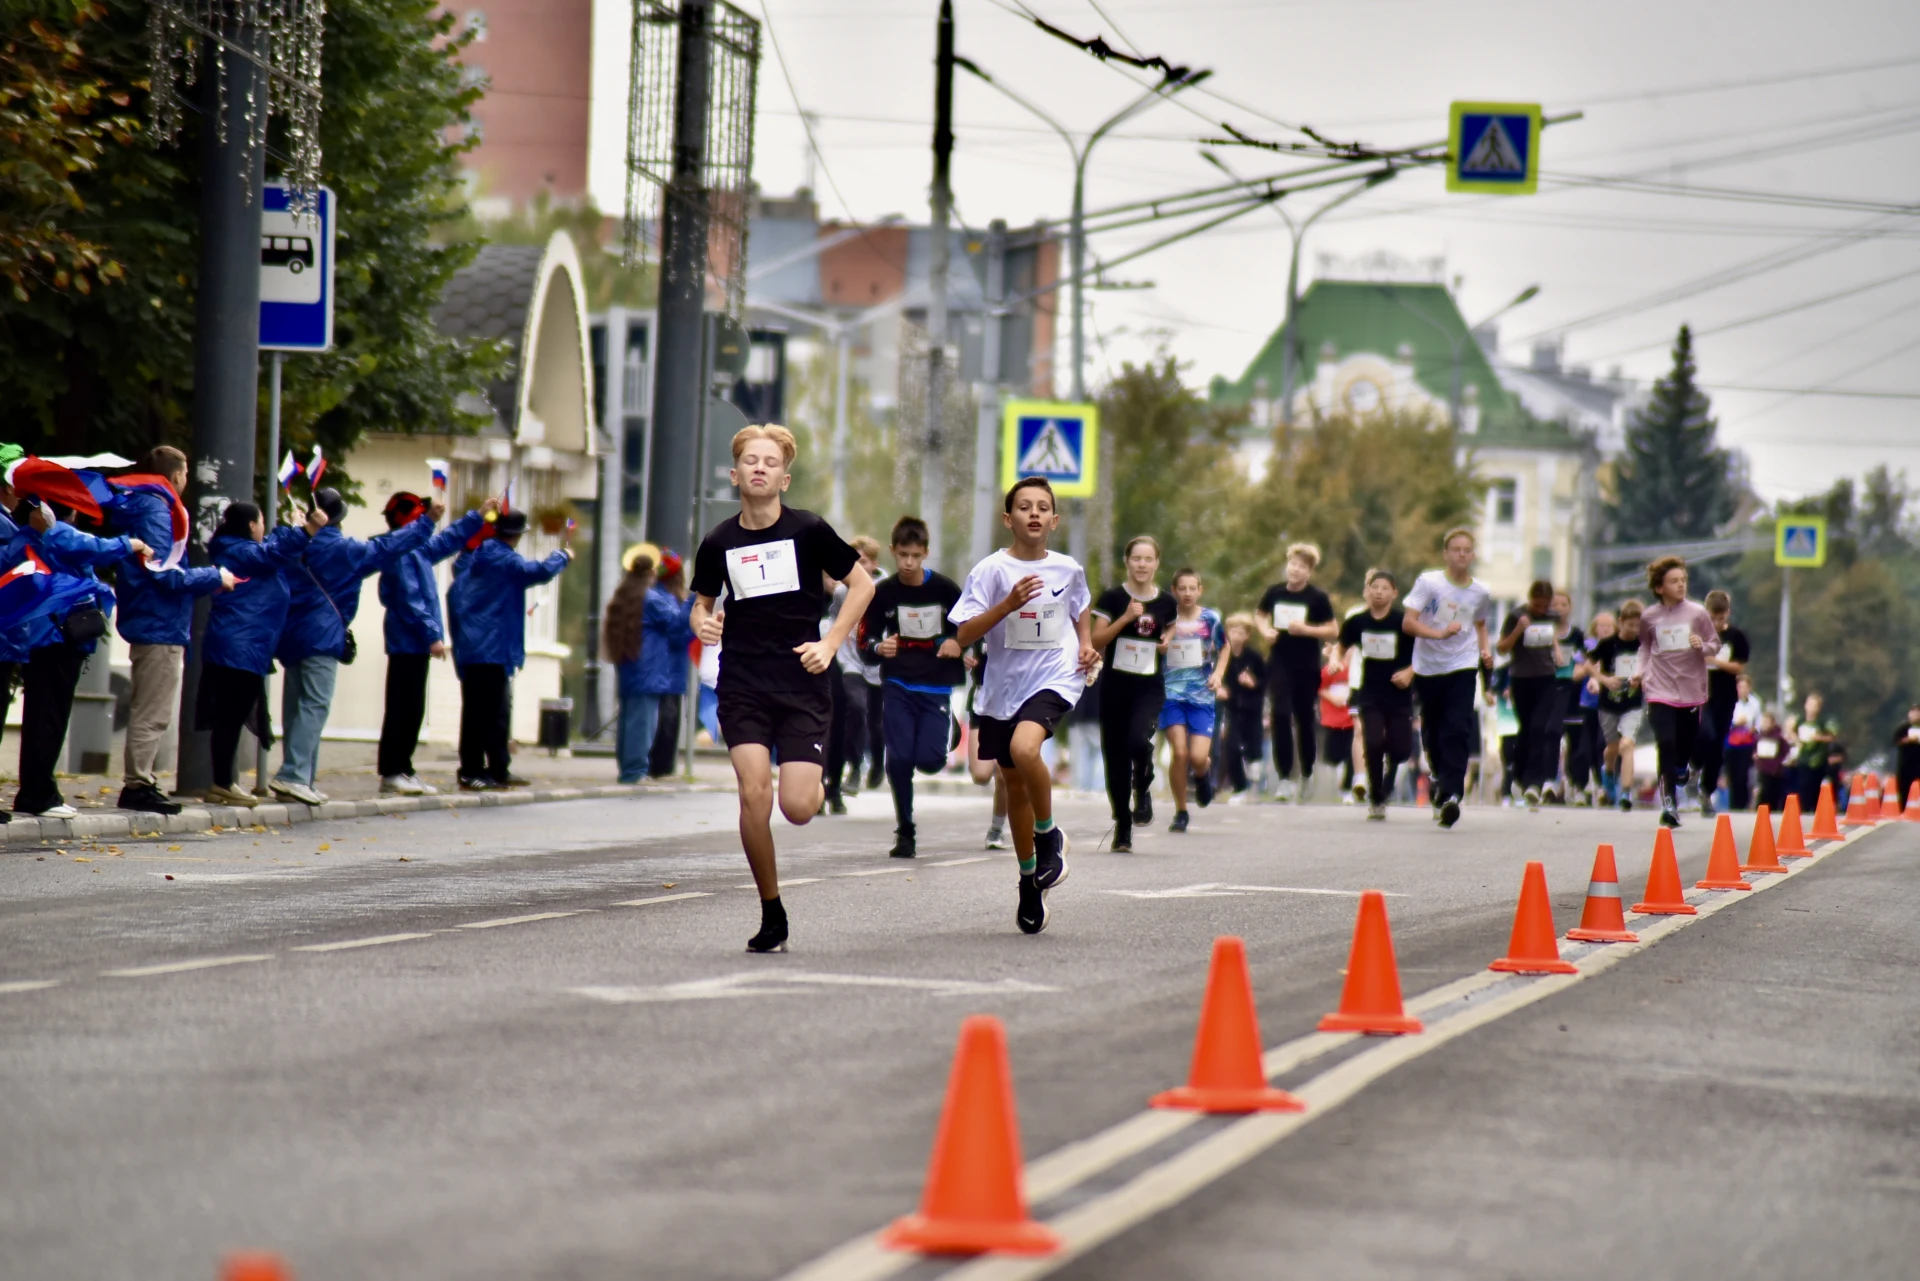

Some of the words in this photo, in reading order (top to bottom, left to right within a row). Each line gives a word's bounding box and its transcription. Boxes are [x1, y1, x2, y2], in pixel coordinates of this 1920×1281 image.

[758, 564, 766, 580] 1
[918, 620, 923, 630] 1
[1035, 622, 1041, 637] 1
[1134, 654, 1138, 664] 1
[1181, 650, 1185, 660] 1
